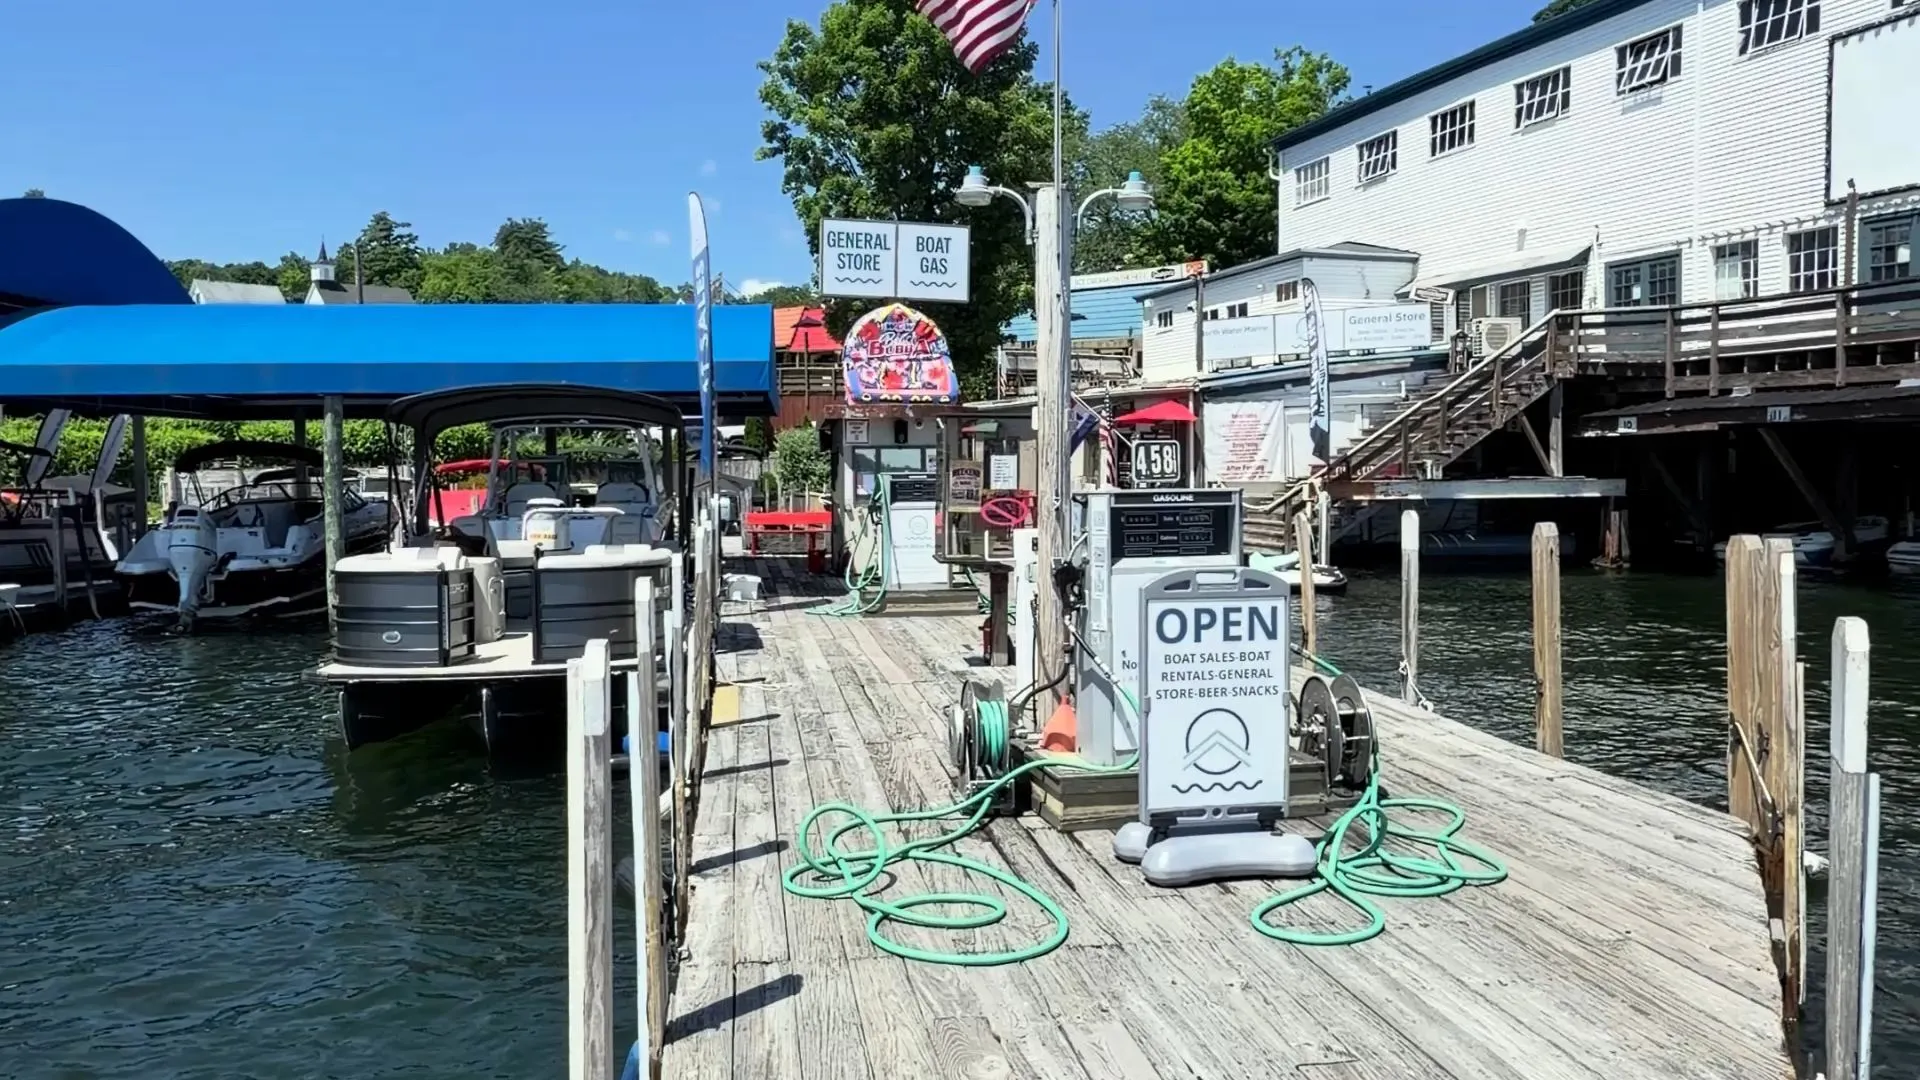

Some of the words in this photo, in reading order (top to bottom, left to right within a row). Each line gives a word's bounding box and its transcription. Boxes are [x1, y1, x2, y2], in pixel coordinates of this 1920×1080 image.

[827, 230, 891, 250] GENERAL
[916, 236, 952, 254] BOAT
[837, 253, 880, 271] STORE
[920, 257, 948, 275] GAS
[1349, 312, 1392, 325] General
[1395, 312, 1426, 322] Store
[1153, 494, 1195, 502] GASOLINE
[1156, 606, 1278, 644] OPEN
[1164, 653, 1197, 664] BOAT
